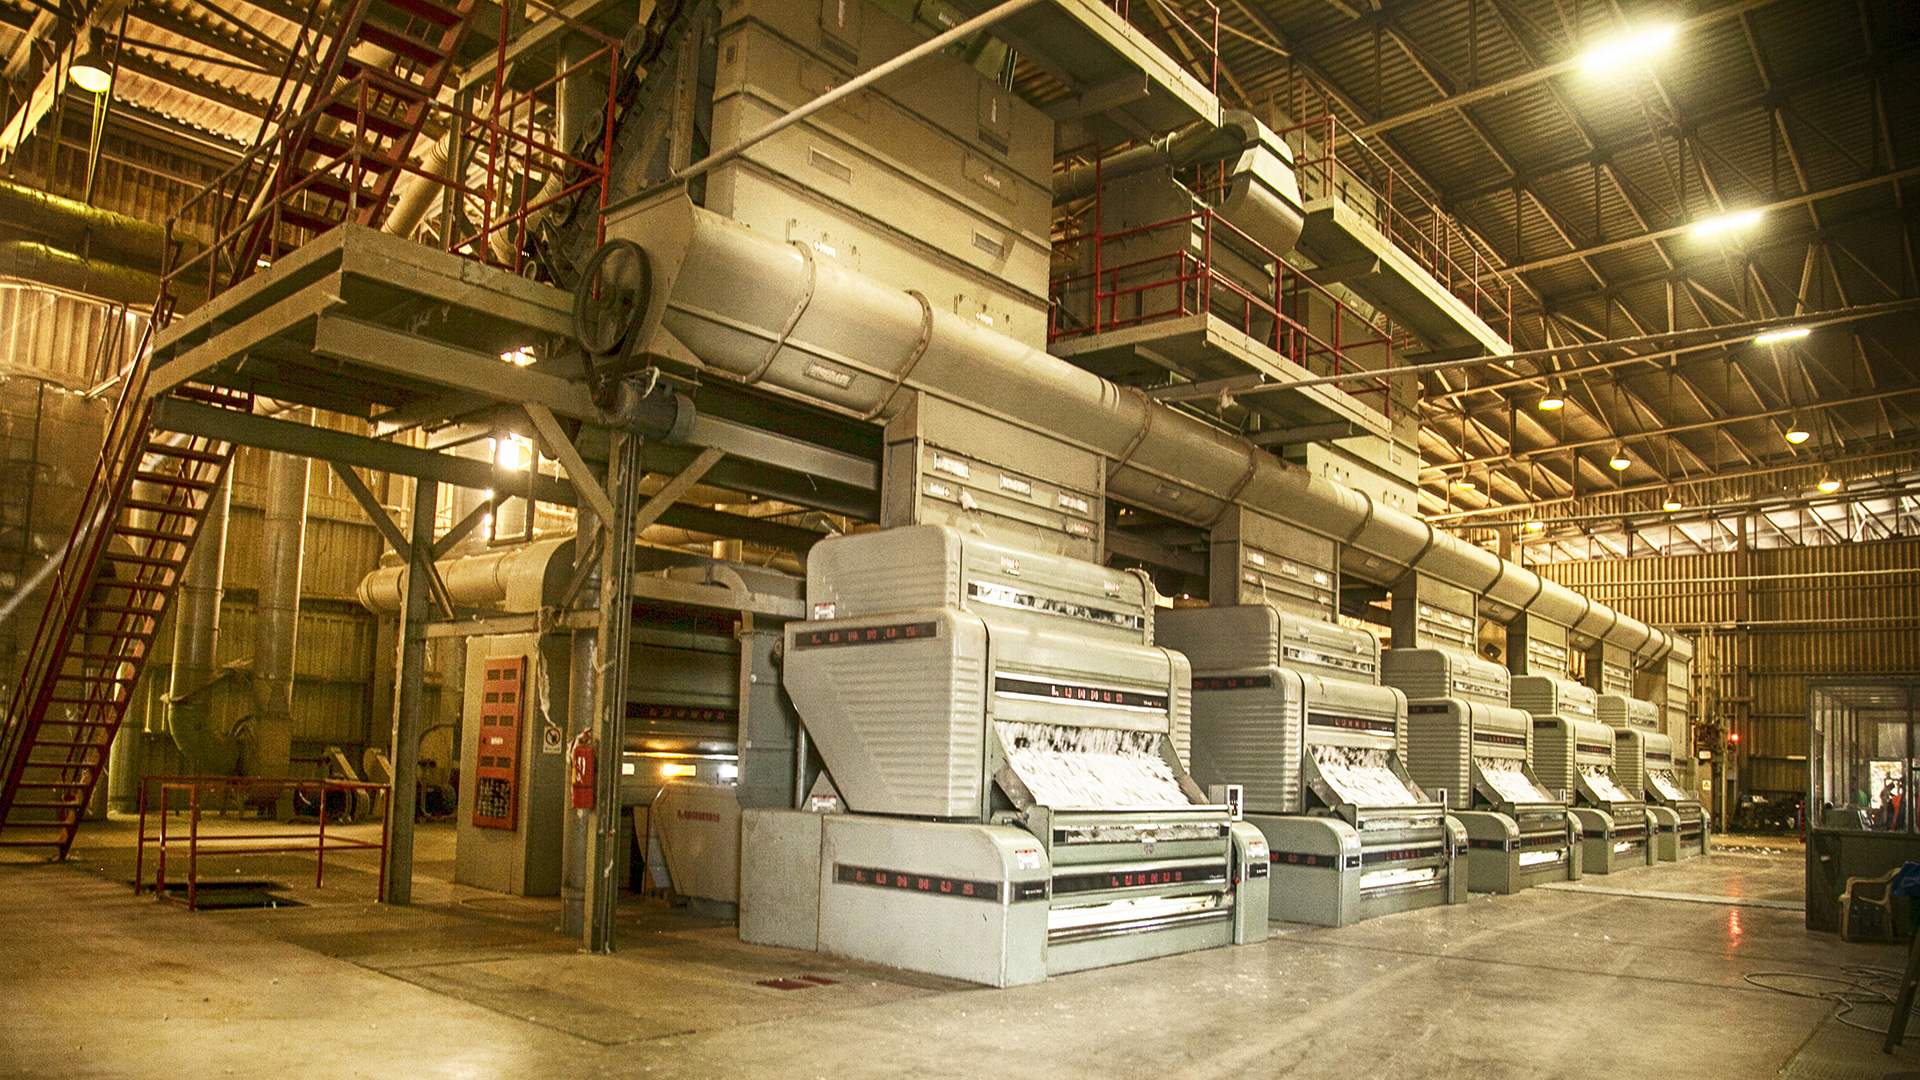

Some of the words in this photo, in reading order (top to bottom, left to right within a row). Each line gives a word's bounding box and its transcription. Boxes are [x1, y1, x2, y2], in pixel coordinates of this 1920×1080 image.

[811, 626, 916, 644] LUMMUS
[1051, 684, 1123, 703] LUMMUS
[856, 871, 974, 895] LUMMUS
[1111, 871, 1182, 887] LUMMUS
